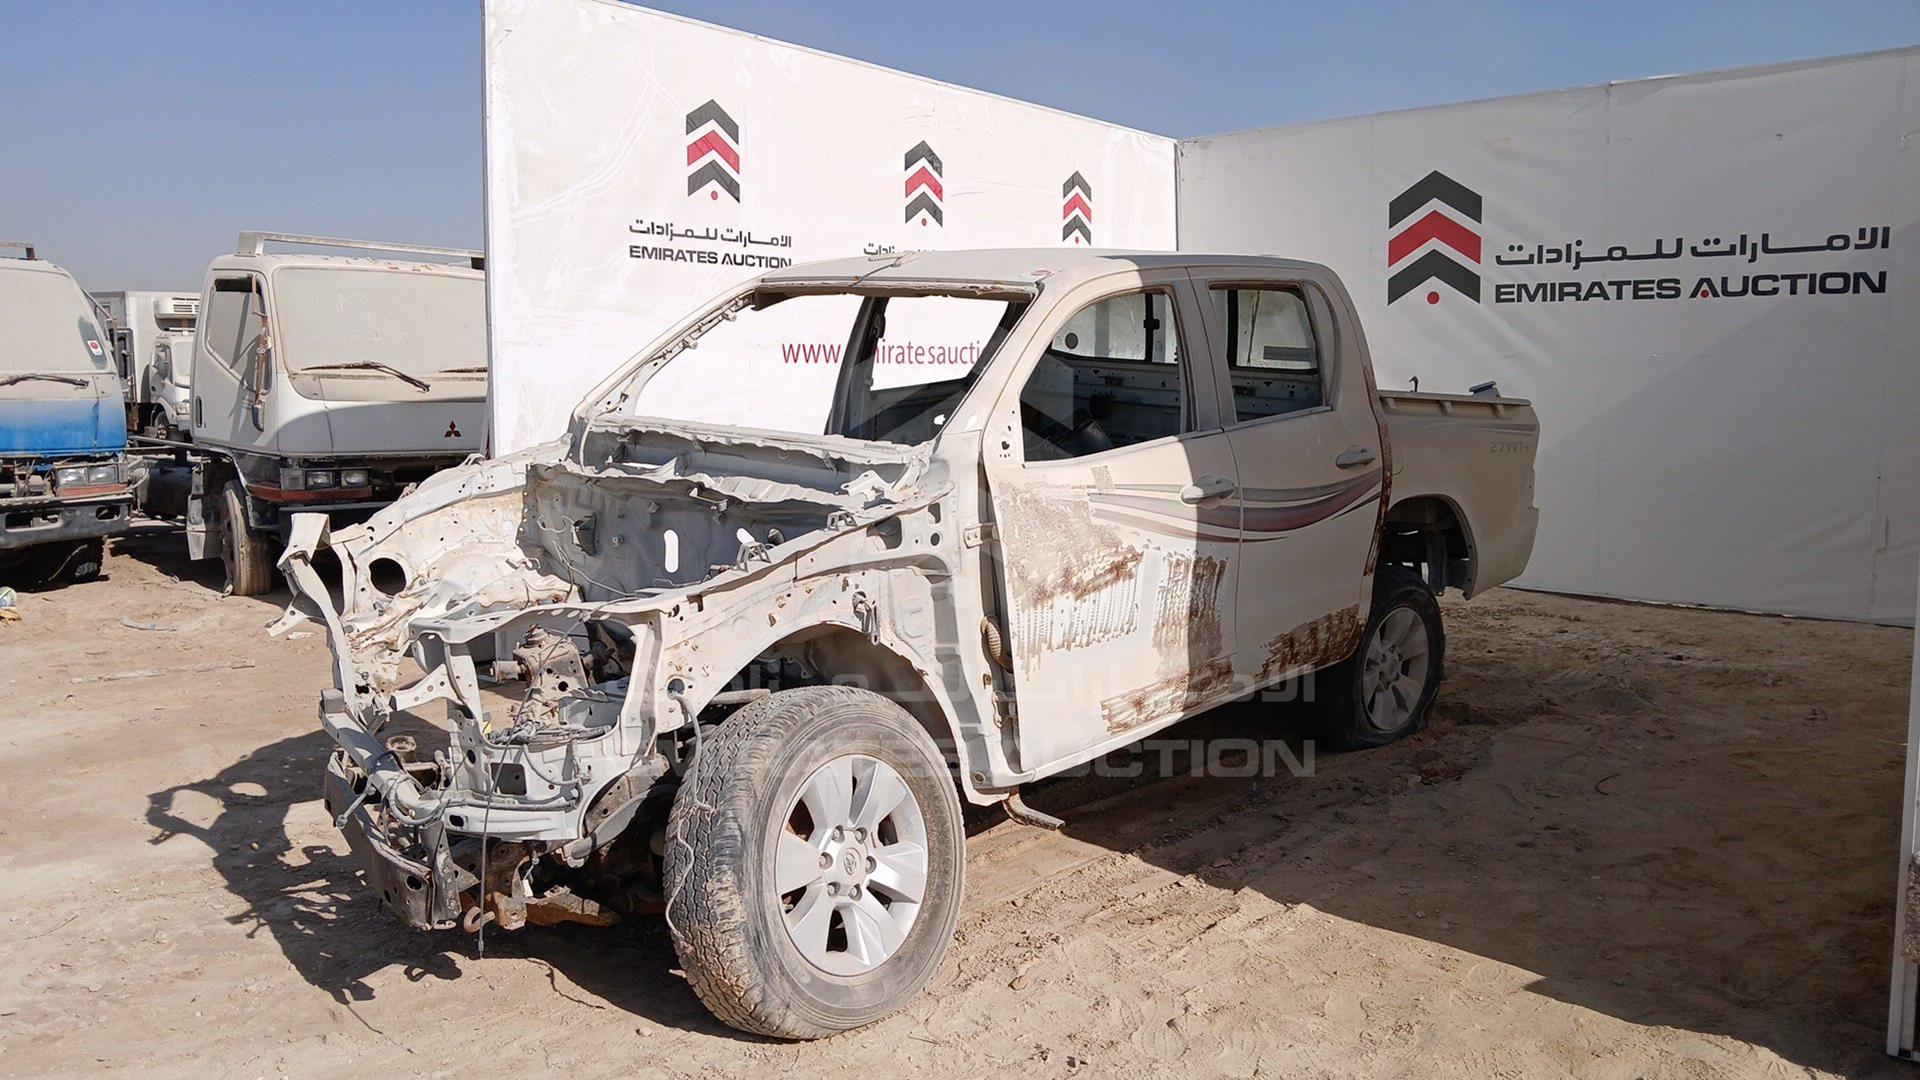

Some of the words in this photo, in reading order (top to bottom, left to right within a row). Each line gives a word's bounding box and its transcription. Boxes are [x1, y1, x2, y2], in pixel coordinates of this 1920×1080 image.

[629, 245, 718, 265] EMIRATES
[721, 253, 792, 269] AUCTION
[1495, 280, 1682, 304] EMIRATES
[1688, 271, 1888, 300] AUCTION
